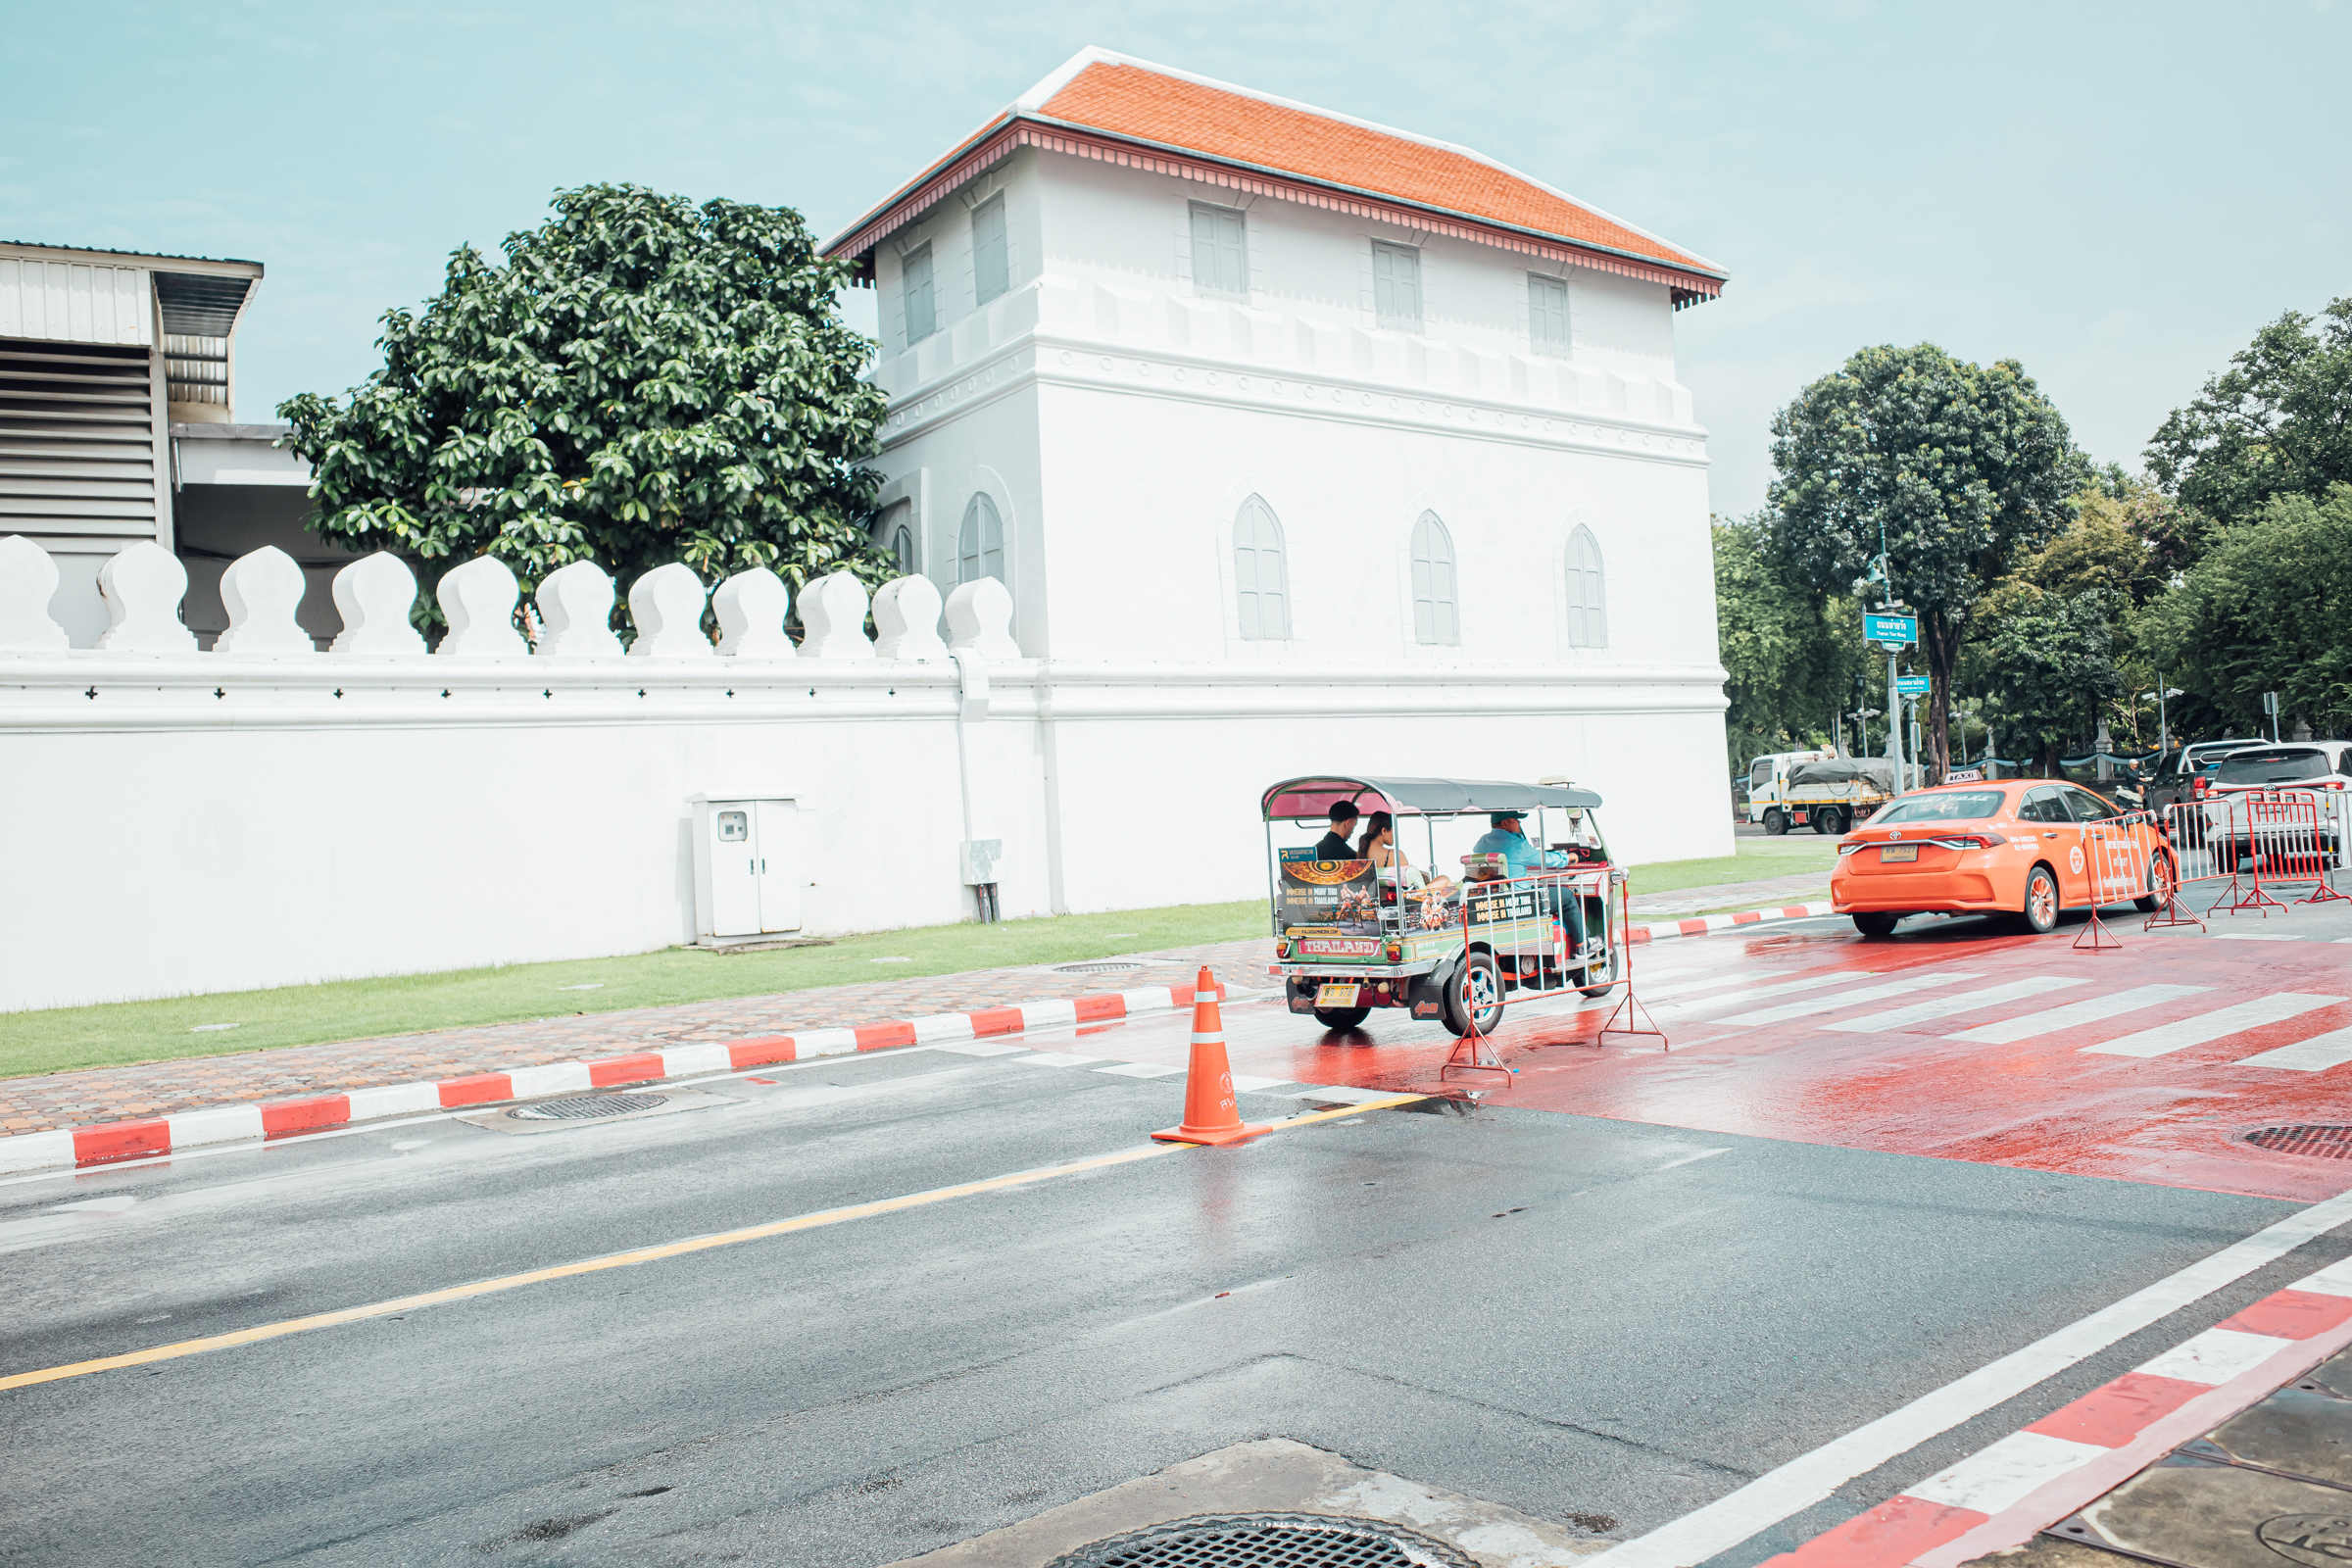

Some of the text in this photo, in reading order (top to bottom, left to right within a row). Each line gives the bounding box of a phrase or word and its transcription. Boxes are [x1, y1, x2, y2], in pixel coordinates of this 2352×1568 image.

[1313, 887, 1327, 896] MUAY
[1327, 887, 1338, 896] THAI
[1286, 896, 1339, 906] IMMERSE IN THAILAND
[1475, 895, 1531, 910] IMMESE IN MUY THAI
[1476, 906, 1533, 922] IMMESE IN THILAND
[1304, 941, 1374, 954] THAILAND
